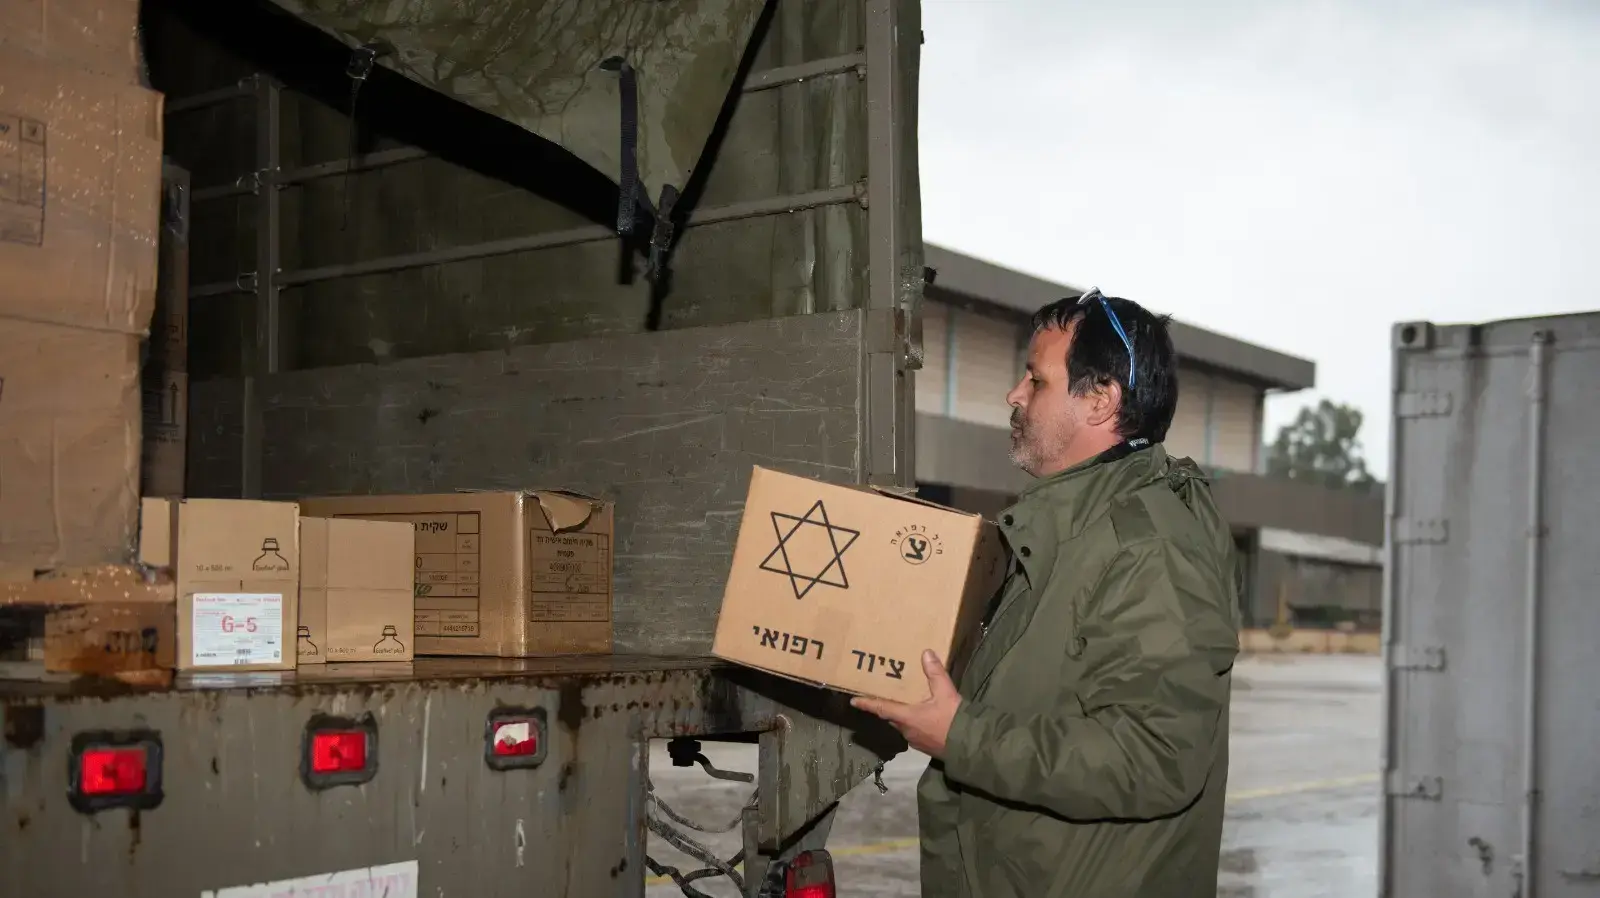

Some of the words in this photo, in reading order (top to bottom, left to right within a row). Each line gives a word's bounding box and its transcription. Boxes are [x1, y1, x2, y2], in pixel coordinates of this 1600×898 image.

[421, 521, 448, 534] שקית
[890, 524, 926, 545] רפואה
[221, 615, 258, 633] G-5
[752, 625, 825, 660] רפואי
[851, 649, 906, 680] ציוד
